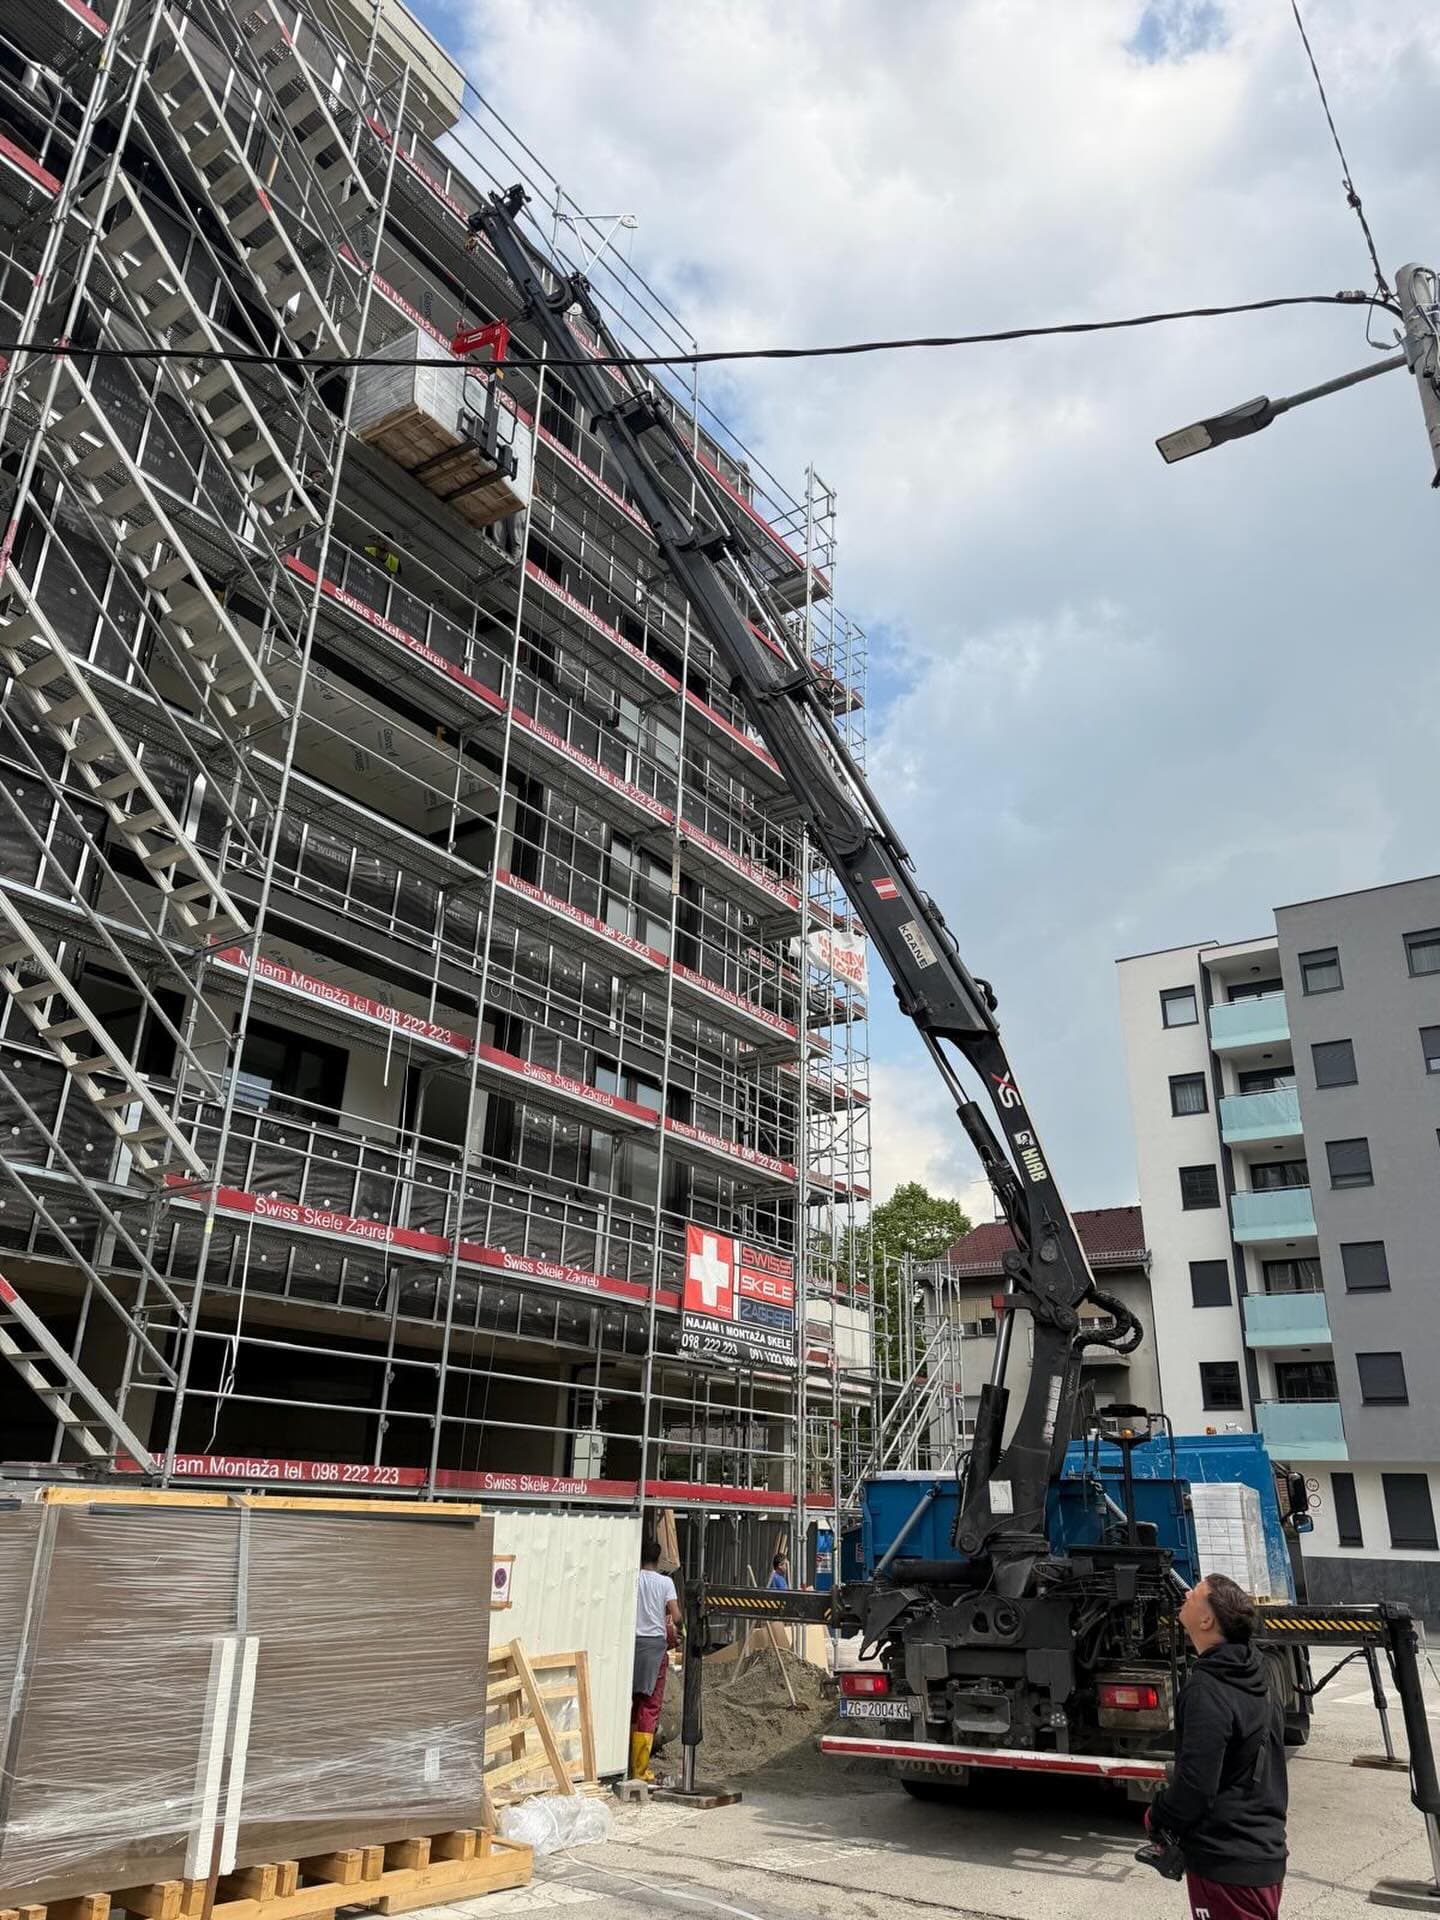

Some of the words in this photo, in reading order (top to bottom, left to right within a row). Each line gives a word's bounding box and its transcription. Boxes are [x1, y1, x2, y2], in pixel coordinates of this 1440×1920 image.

[335, 587, 370, 619] Swiss
[373, 613, 405, 642] Skele
[543, 894, 582, 921] Montaža
[900, 924, 928, 969] KRANE
[291, 971, 350, 1007] Montaža
[354, 994, 373, 1017] tel.
[376, 1004, 400, 1025] 098
[403, 1015, 427, 1035] 222
[429, 1024, 452, 1044] 223
[523, 1062, 552, 1083] Swiss
[554, 1074, 581, 1094] Skele
[582, 1085, 614, 1107] Zagreb
[1021, 1147, 1048, 1182] HIAB
[255, 1197, 299, 1221] Swiss
[304, 1208, 343, 1230] Skele
[346, 1219, 395, 1241] Zagreb
[503, 1253, 534, 1273] Swiss
[536, 1261, 564, 1280] Skele
[566, 1268, 600, 1288] Zagreb
[742, 1247, 792, 1275] SWISS
[741, 1275, 793, 1300] SKELE
[742, 1302, 792, 1328] ZAGREB
[681, 1333, 700, 1349] 098
[703, 1337, 721, 1353] 222
[721, 1341, 738, 1356] 223
[686, 1316, 720, 1332] NAJAM
[726, 1325, 766, 1345] MONTAŽA
[767, 1335, 792, 1350] SKELE
[749, 1347, 763, 1361] 091
[210, 1457, 279, 1478] Montaža
[284, 1461, 305, 1479] tel.
[311, 1463, 338, 1481] 098
[343, 1465, 369, 1483] 222
[373, 1467, 399, 1484] 223
[484, 1473, 517, 1490] Swiss
[520, 1475, 549, 1492] Skele
[552, 1478, 588, 1494] Zagreb
[848, 1702, 862, 1716] ZG
